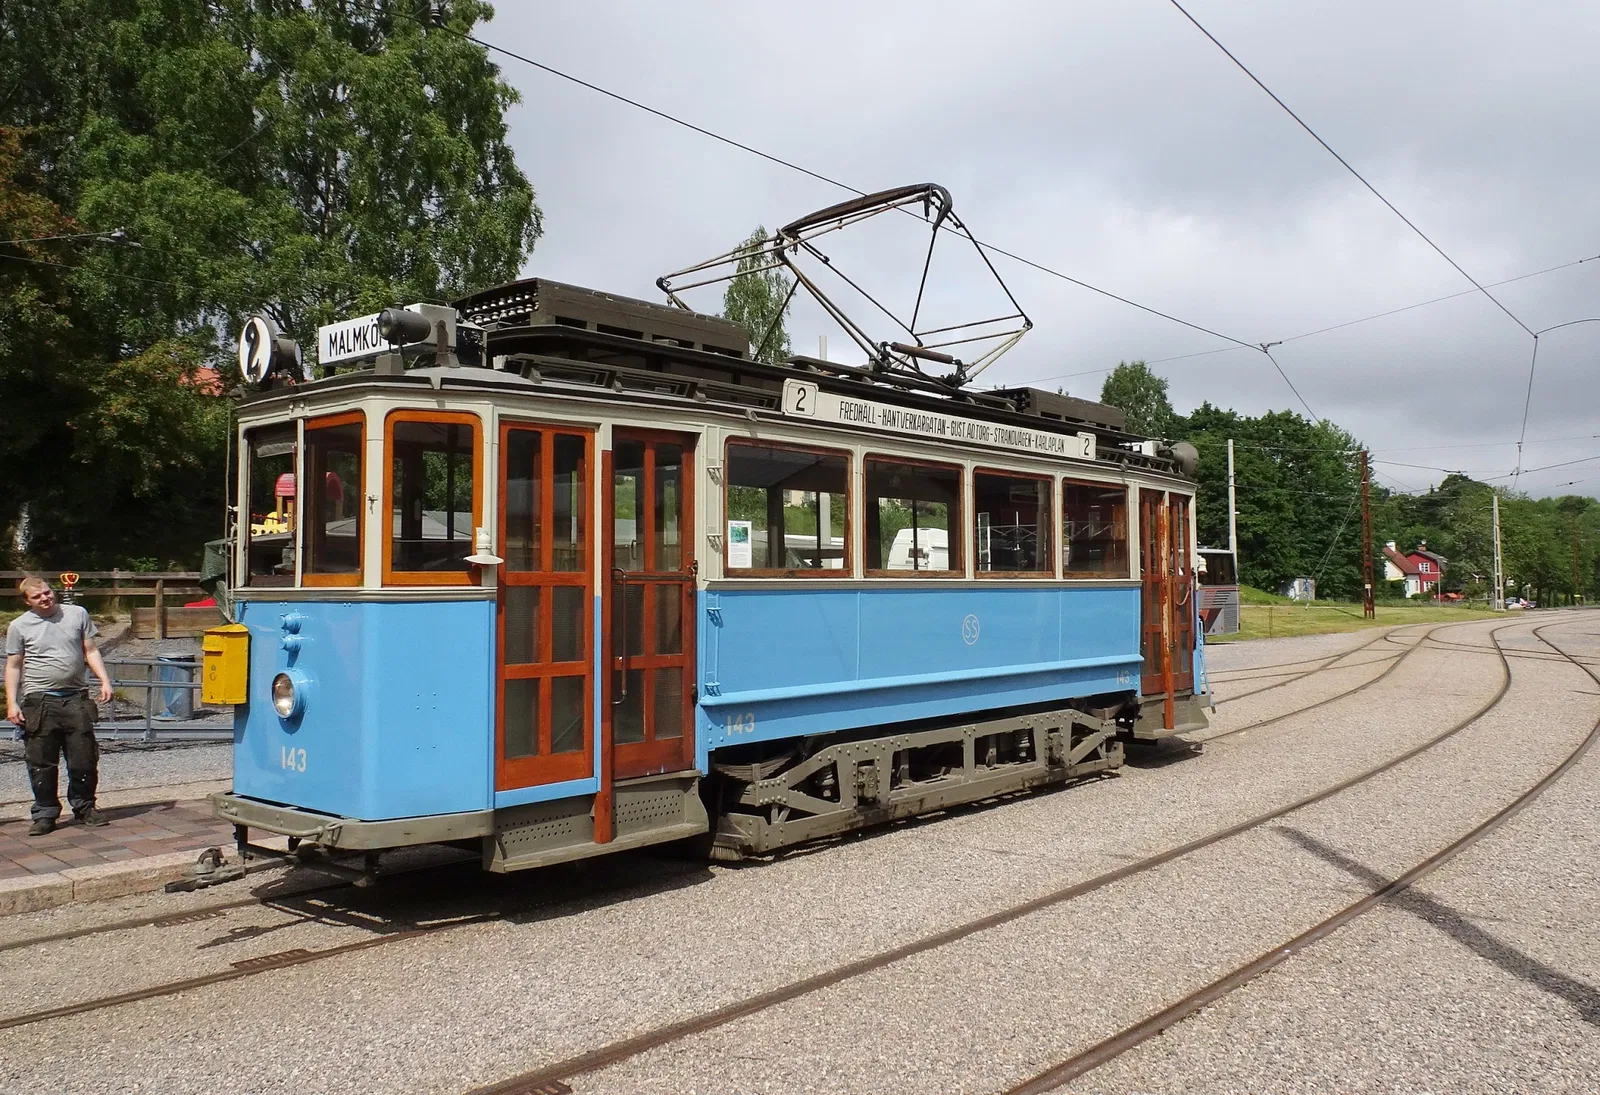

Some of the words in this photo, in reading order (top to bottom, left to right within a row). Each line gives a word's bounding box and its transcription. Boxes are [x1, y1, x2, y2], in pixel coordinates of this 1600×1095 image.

[245, 321, 262, 377] 2
[329, 318, 382, 357] MALMKÖ
[795, 387, 806, 412] 2
[1083, 438, 1090, 456] 2
[1116, 670, 1130, 685] 143
[727, 712, 755, 736] 143
[281, 746, 307, 772] 143
